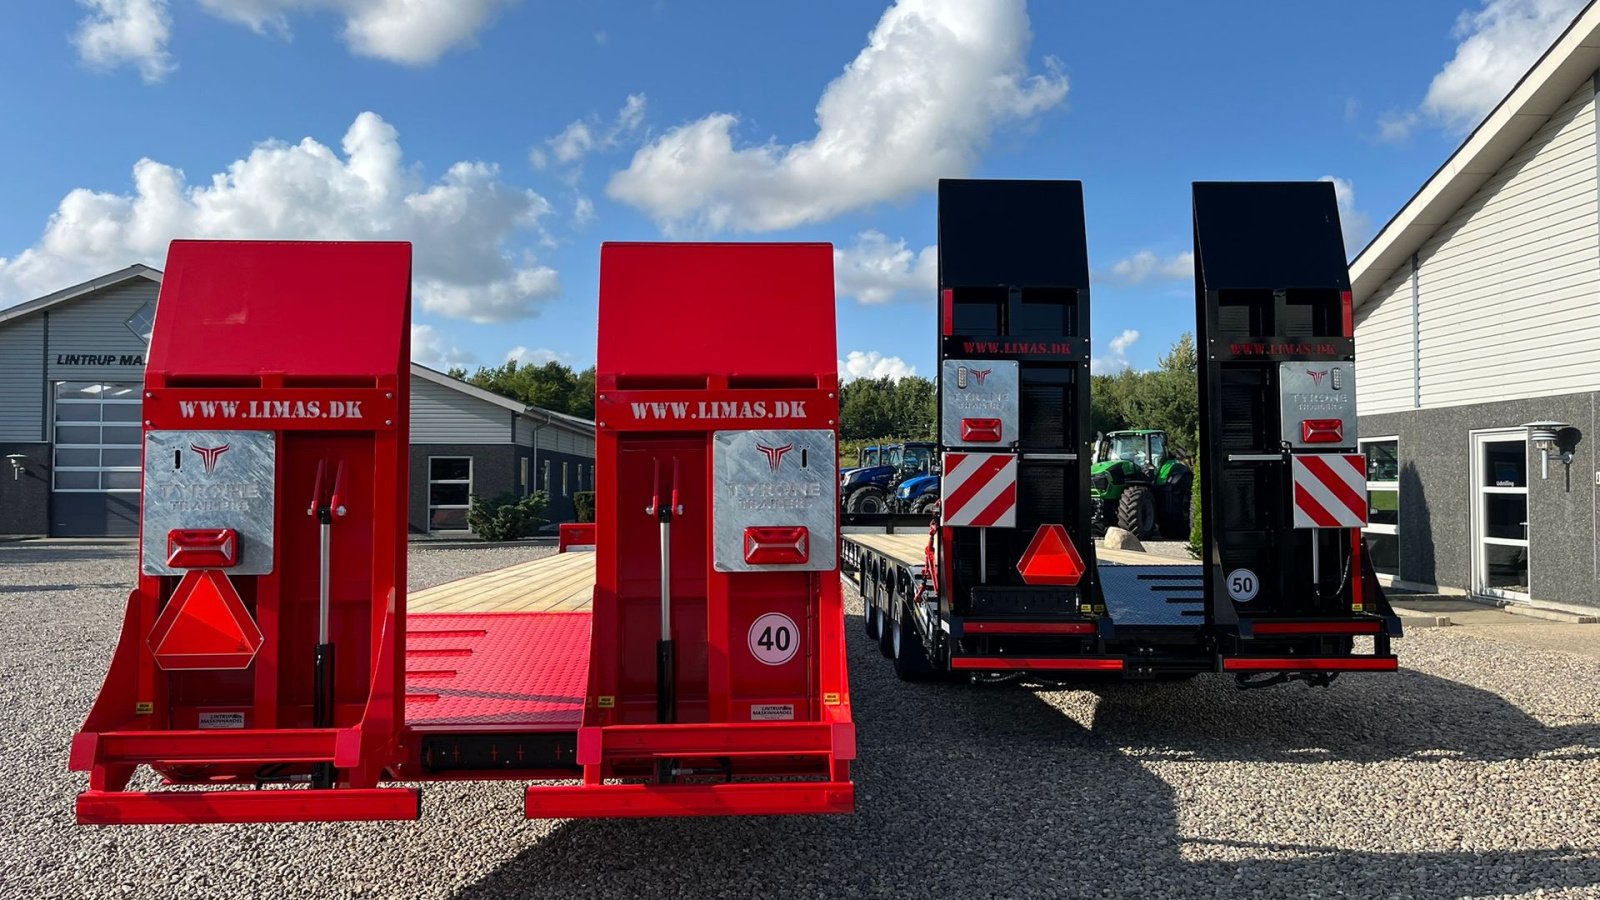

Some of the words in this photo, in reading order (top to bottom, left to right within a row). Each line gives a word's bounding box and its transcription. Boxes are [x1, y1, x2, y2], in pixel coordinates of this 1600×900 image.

[963, 342, 1072, 354] WWW.LIMAS.DK
[1229, 343, 1337, 356] WWW.LIMAS.DK
[56, 354, 116, 366] LINTRUP
[178, 400, 364, 419] WWW.LIMAS.DK
[630, 400, 808, 420] WWW.LIMAS.DK
[158, 482, 259, 499] TYRONE
[724, 481, 822, 497] TYRONE
[1232, 577, 1253, 594] 50
[757, 625, 791, 652] 40
